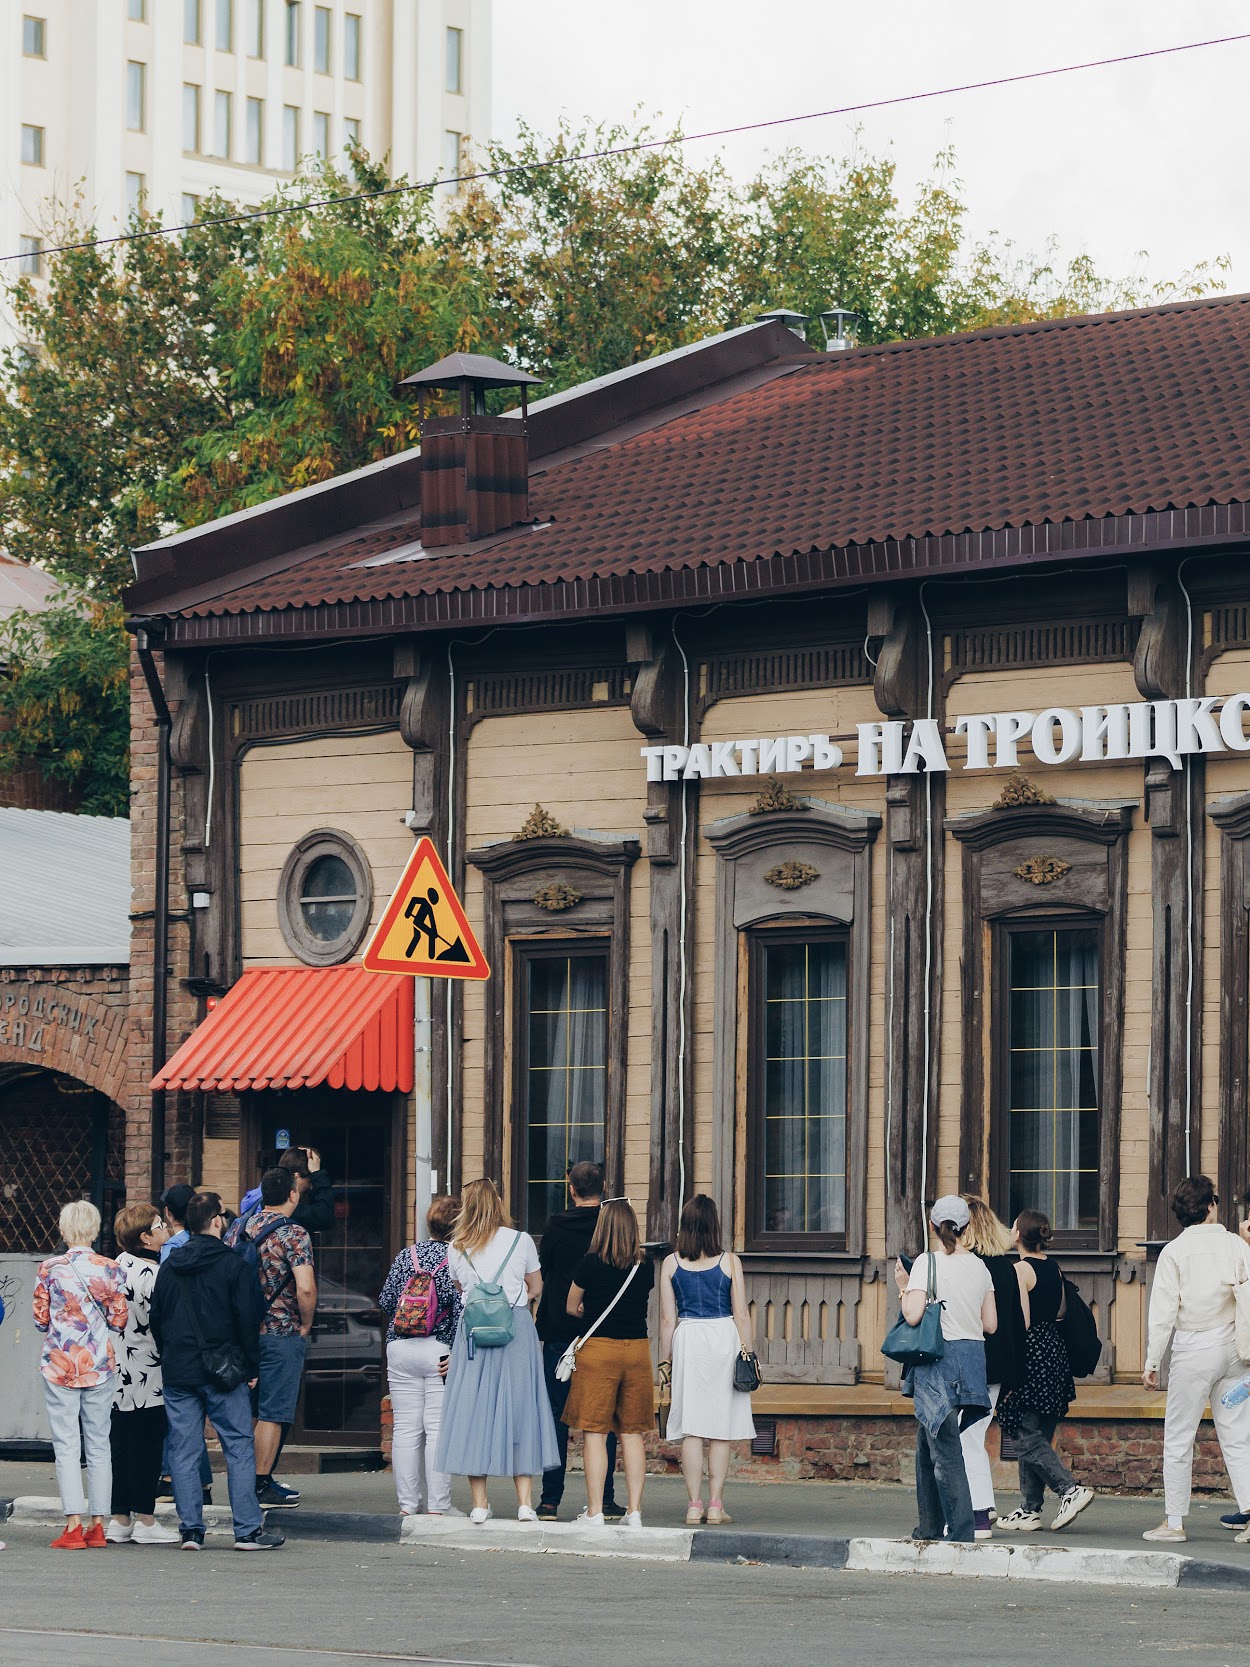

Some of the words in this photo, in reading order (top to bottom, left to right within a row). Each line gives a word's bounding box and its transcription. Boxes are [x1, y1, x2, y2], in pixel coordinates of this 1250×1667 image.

[640, 734, 843, 782] ТРАКТИРЪ
[855, 719, 952, 776] НА
[0, 992, 99, 1040] РОДСКИХ
